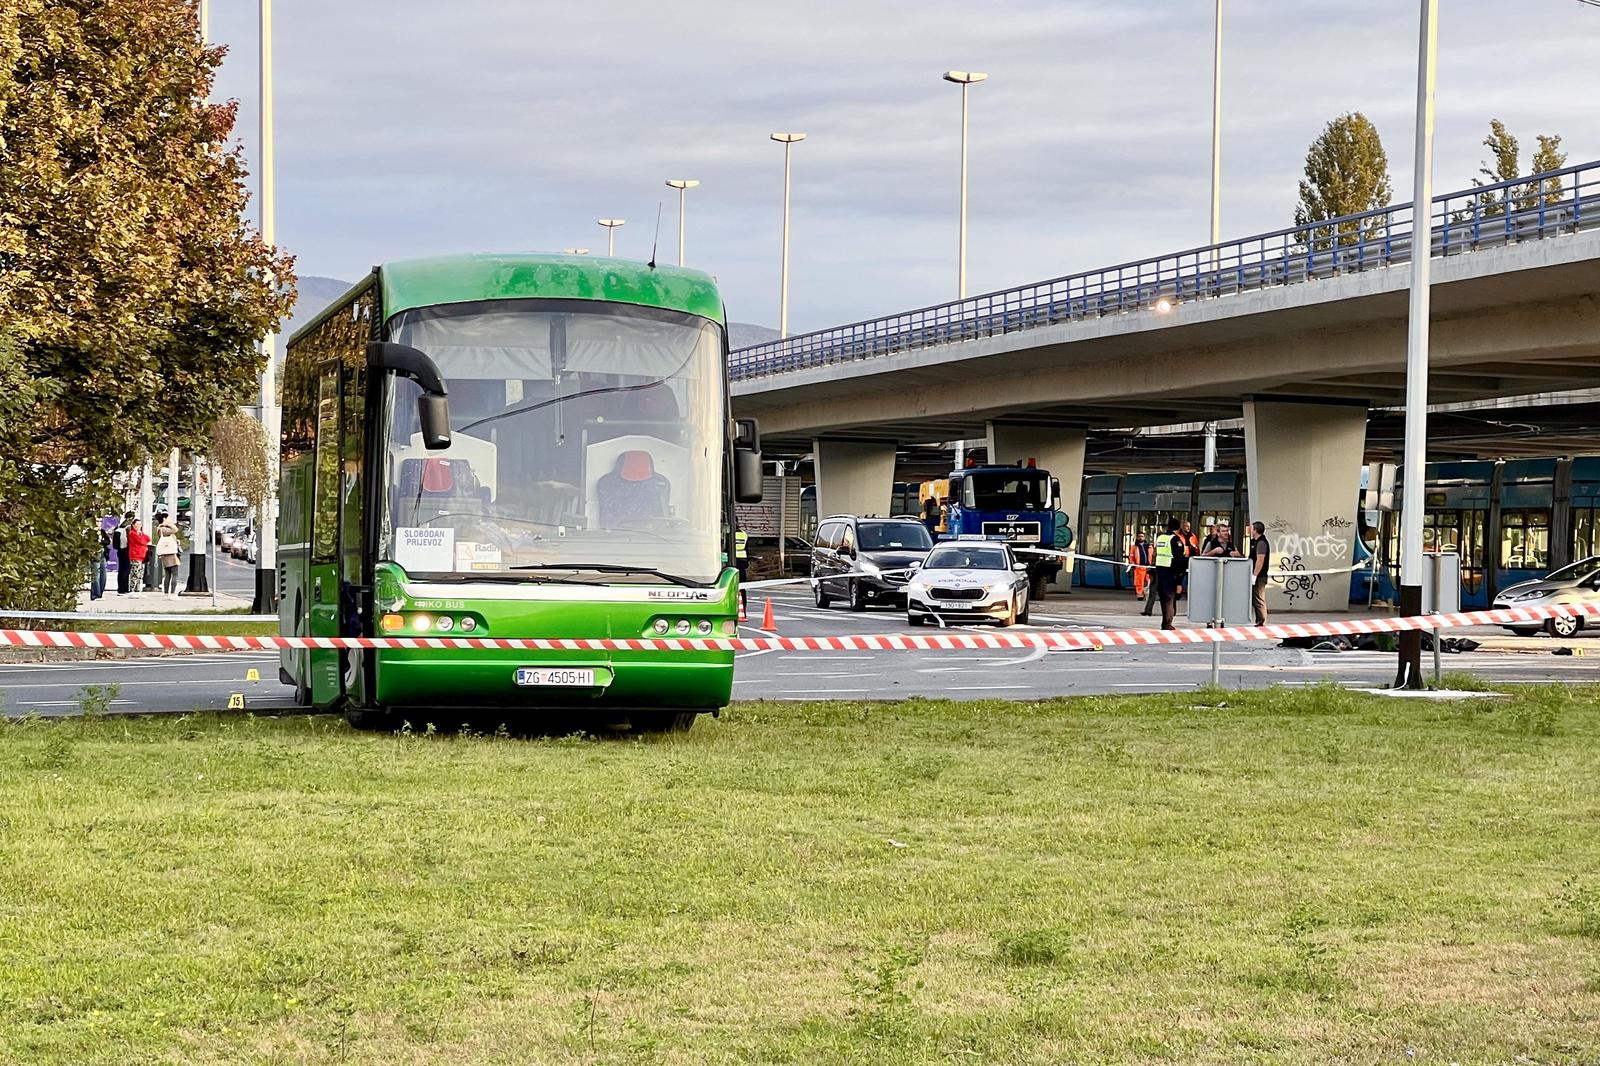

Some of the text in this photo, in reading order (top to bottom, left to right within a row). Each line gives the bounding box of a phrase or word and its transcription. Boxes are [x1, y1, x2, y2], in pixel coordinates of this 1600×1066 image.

[404, 529, 445, 538] SLOBODAN
[406, 538, 443, 546] PRIJEVOZ
[648, 591, 708, 600] NEOPLAN
[445, 600, 465, 609] BUS
[526, 671, 540, 684] ZG
[233, 696, 241, 706] 15
